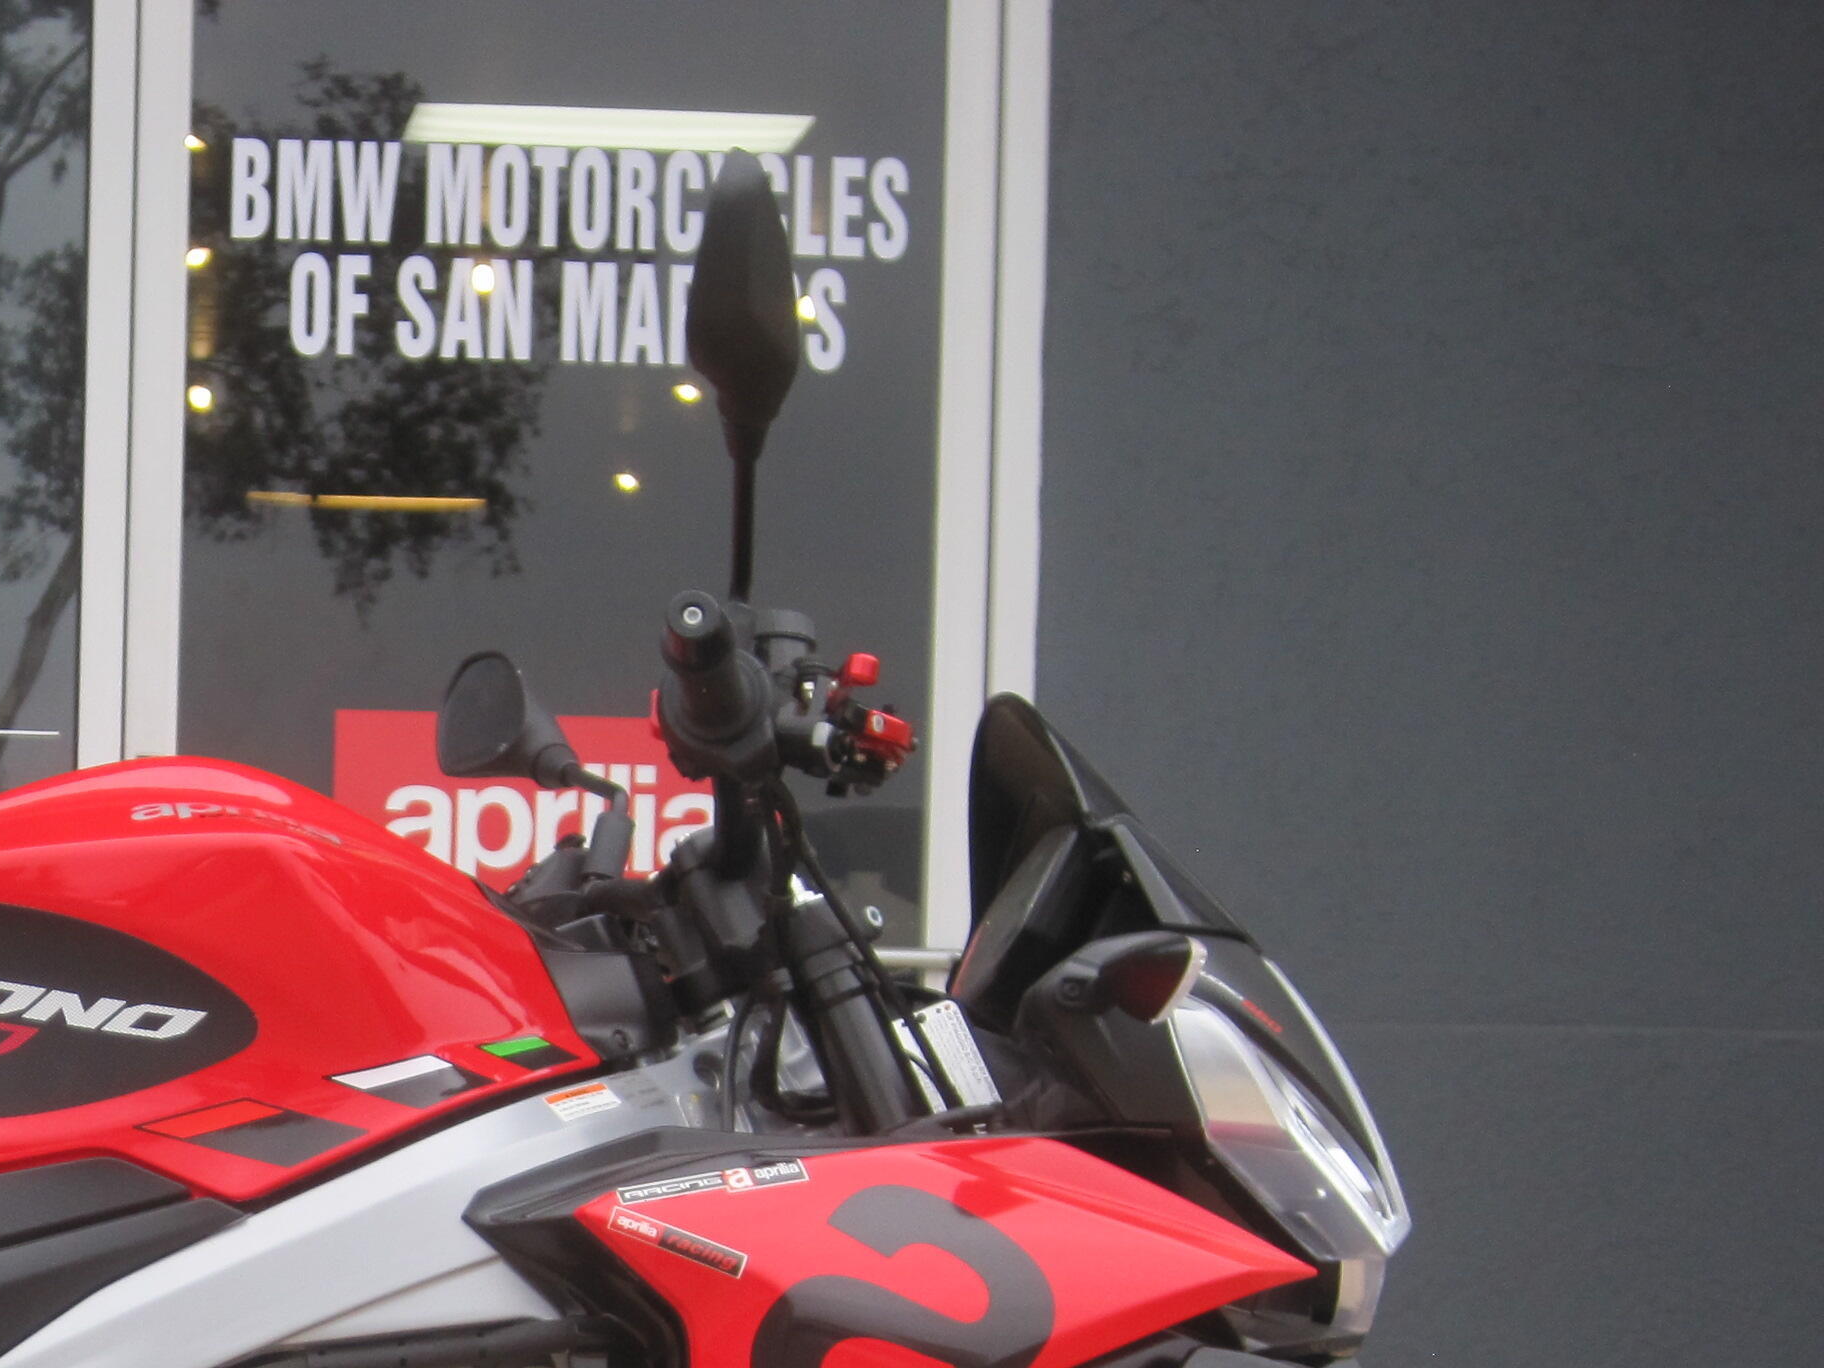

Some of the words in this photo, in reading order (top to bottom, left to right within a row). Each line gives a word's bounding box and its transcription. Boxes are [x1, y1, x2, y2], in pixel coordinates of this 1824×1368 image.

[230, 137, 402, 243] BMW
[426, 142, 910, 262] MOTORCLES
[290, 252, 373, 356] OF
[396, 255, 534, 361] SAN
[560, 261, 847, 373] MAS
[754, 1160, 801, 1180] aprilia
[616, 1214, 659, 1238] aprilia
[667, 1234, 739, 1271] racing
